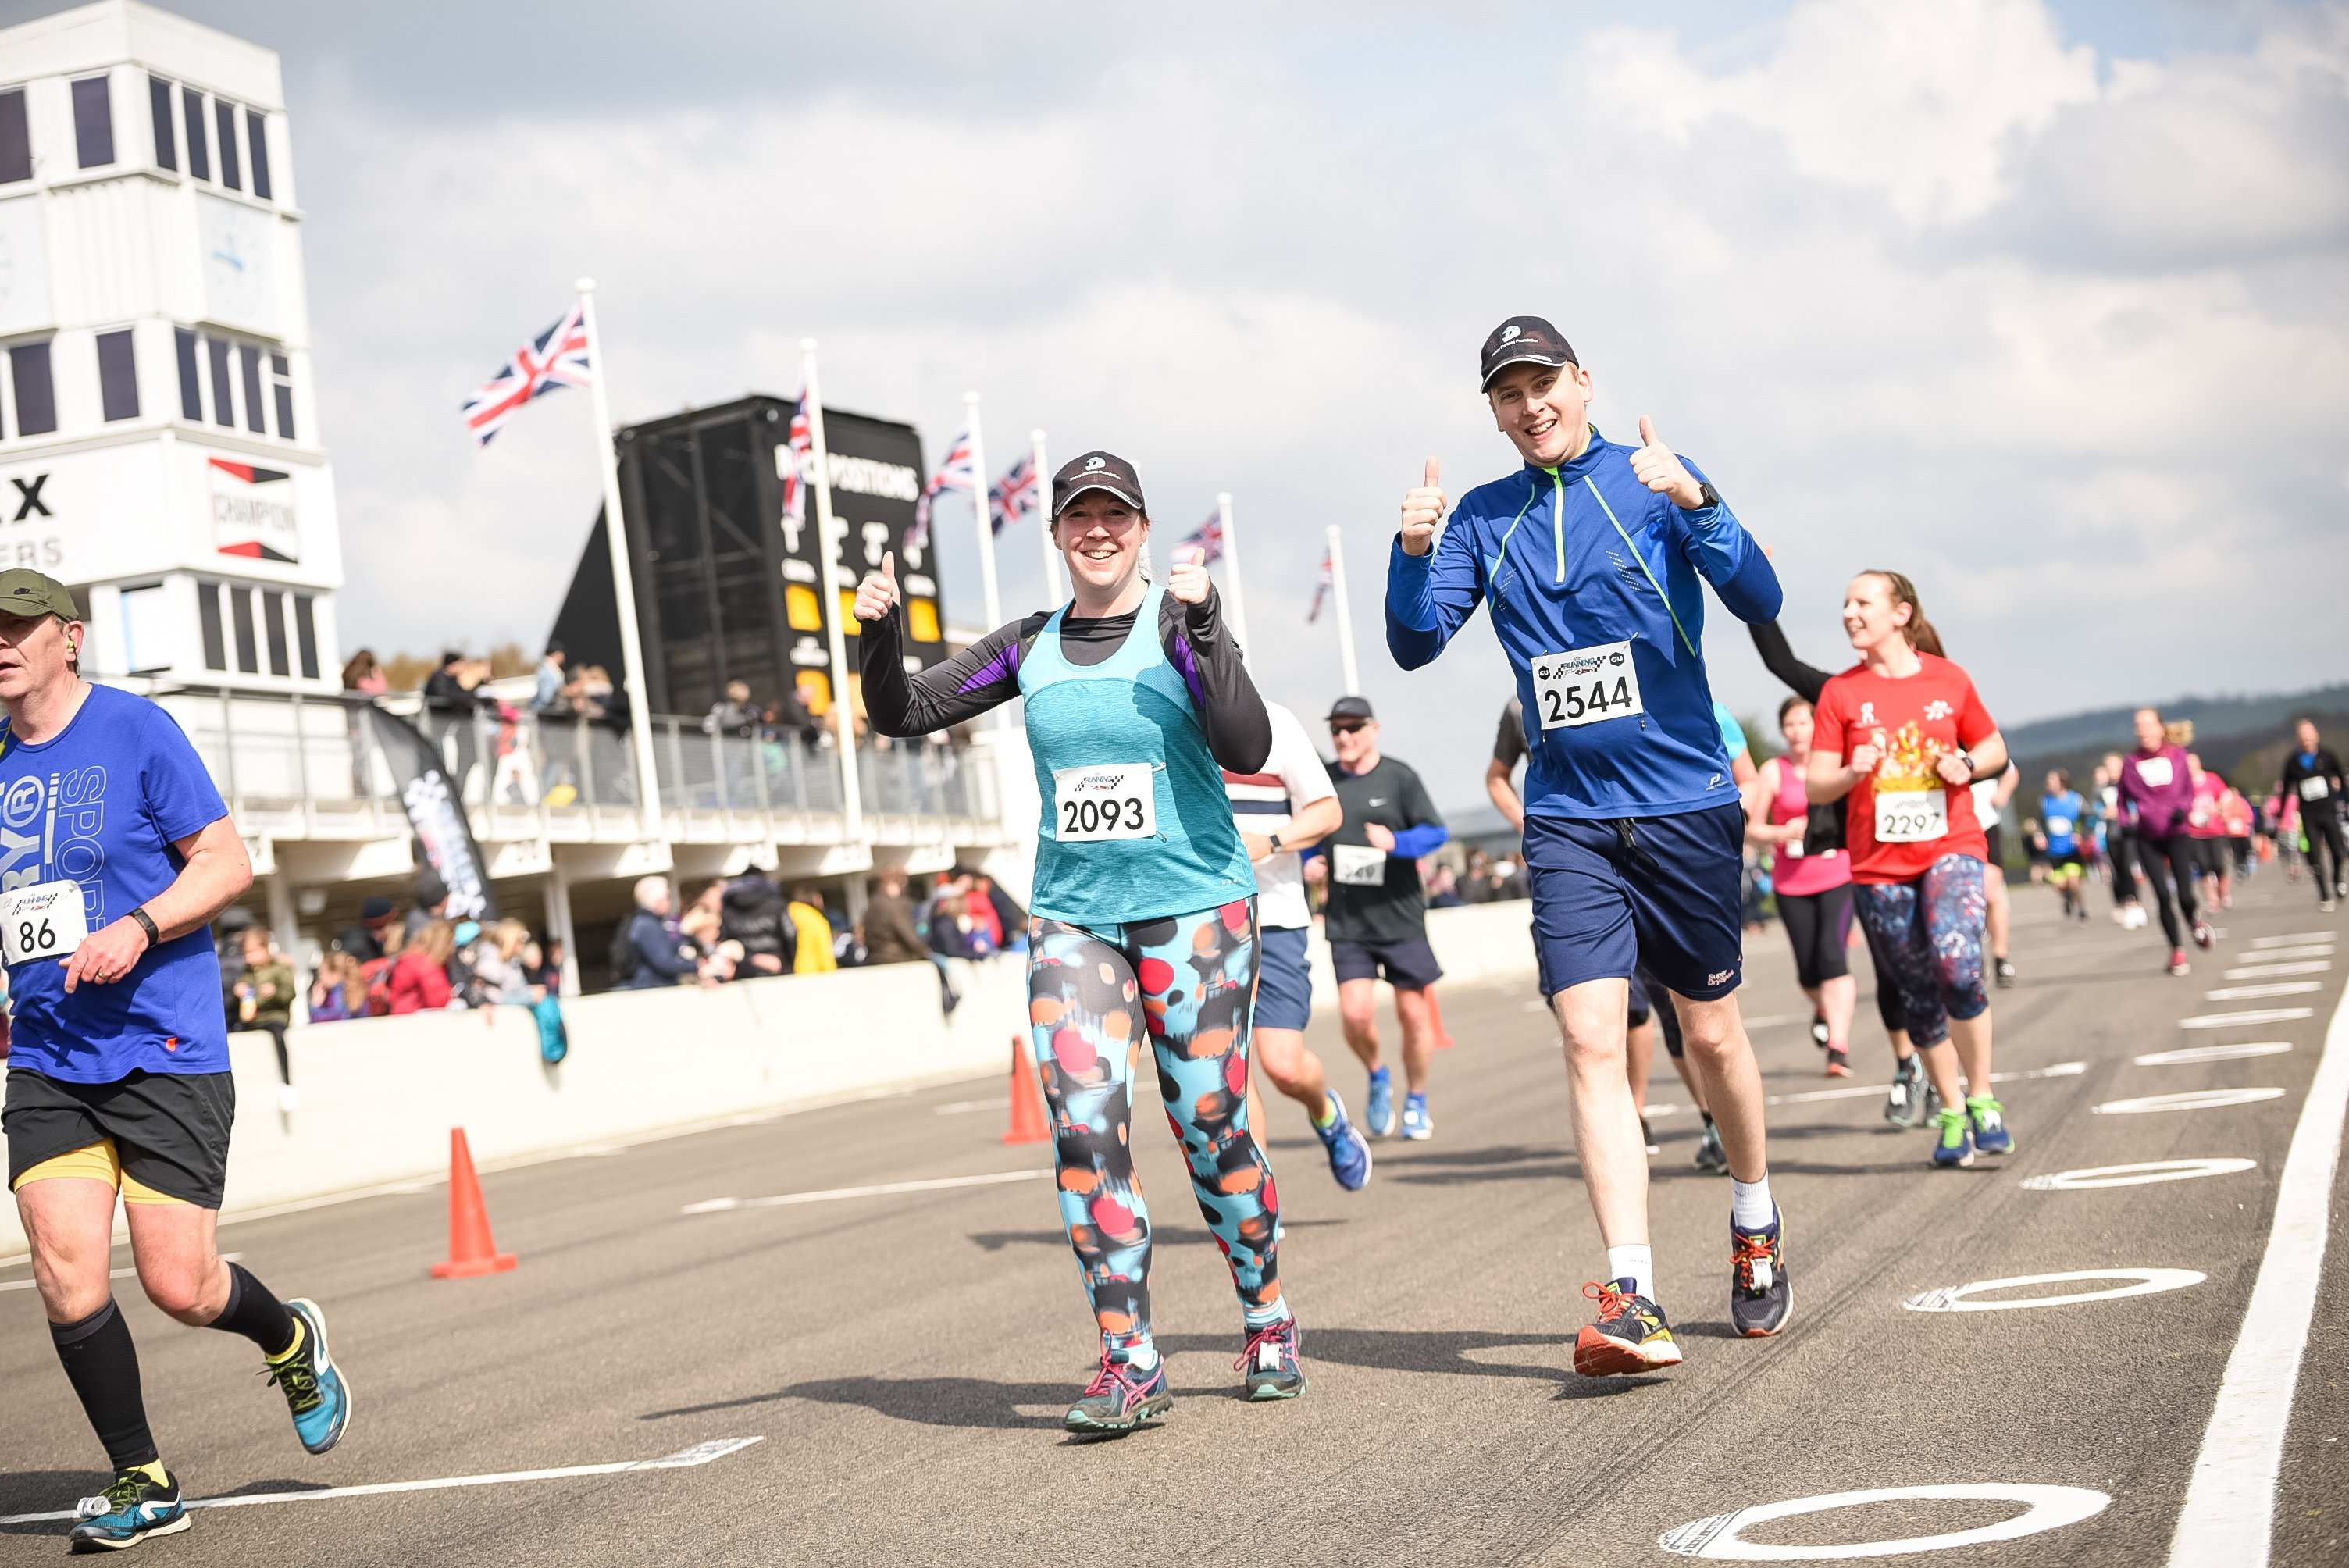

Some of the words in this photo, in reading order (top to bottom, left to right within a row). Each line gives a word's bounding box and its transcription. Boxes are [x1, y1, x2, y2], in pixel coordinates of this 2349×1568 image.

[1545, 676, 1632, 722] 2544
[1064, 797, 1144, 832] 2093
[1884, 812, 1940, 835] 2297
[20, 918, 55, 953] 86
